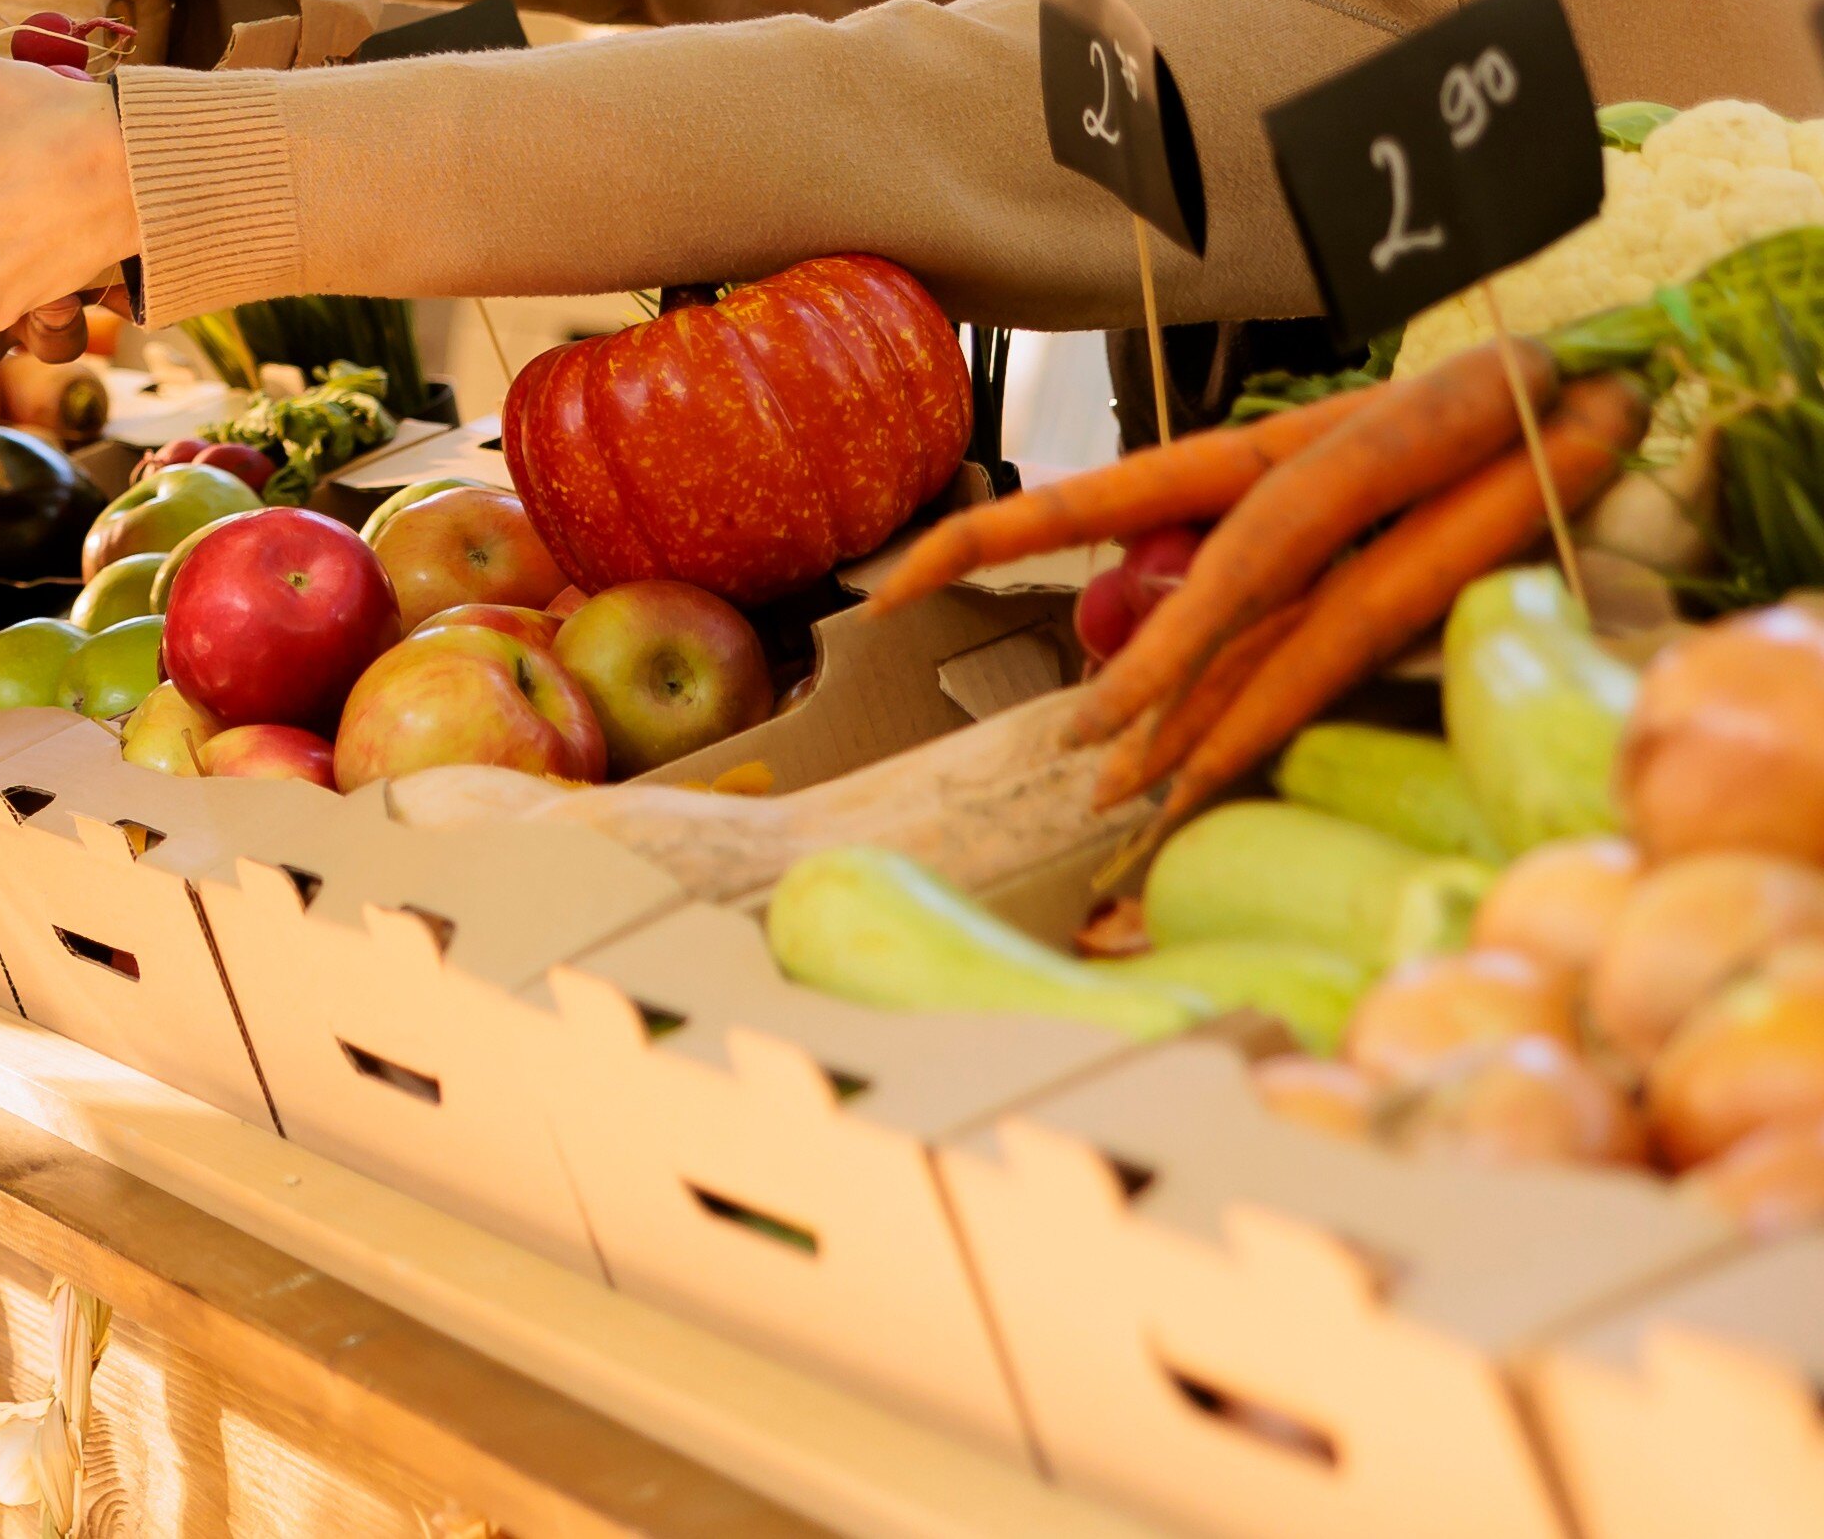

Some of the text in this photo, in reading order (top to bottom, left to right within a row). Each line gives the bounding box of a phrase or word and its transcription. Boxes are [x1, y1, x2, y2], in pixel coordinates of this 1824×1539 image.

[1083, 41, 1120, 145] 2
[1370, 46, 1519, 272] 2 90
